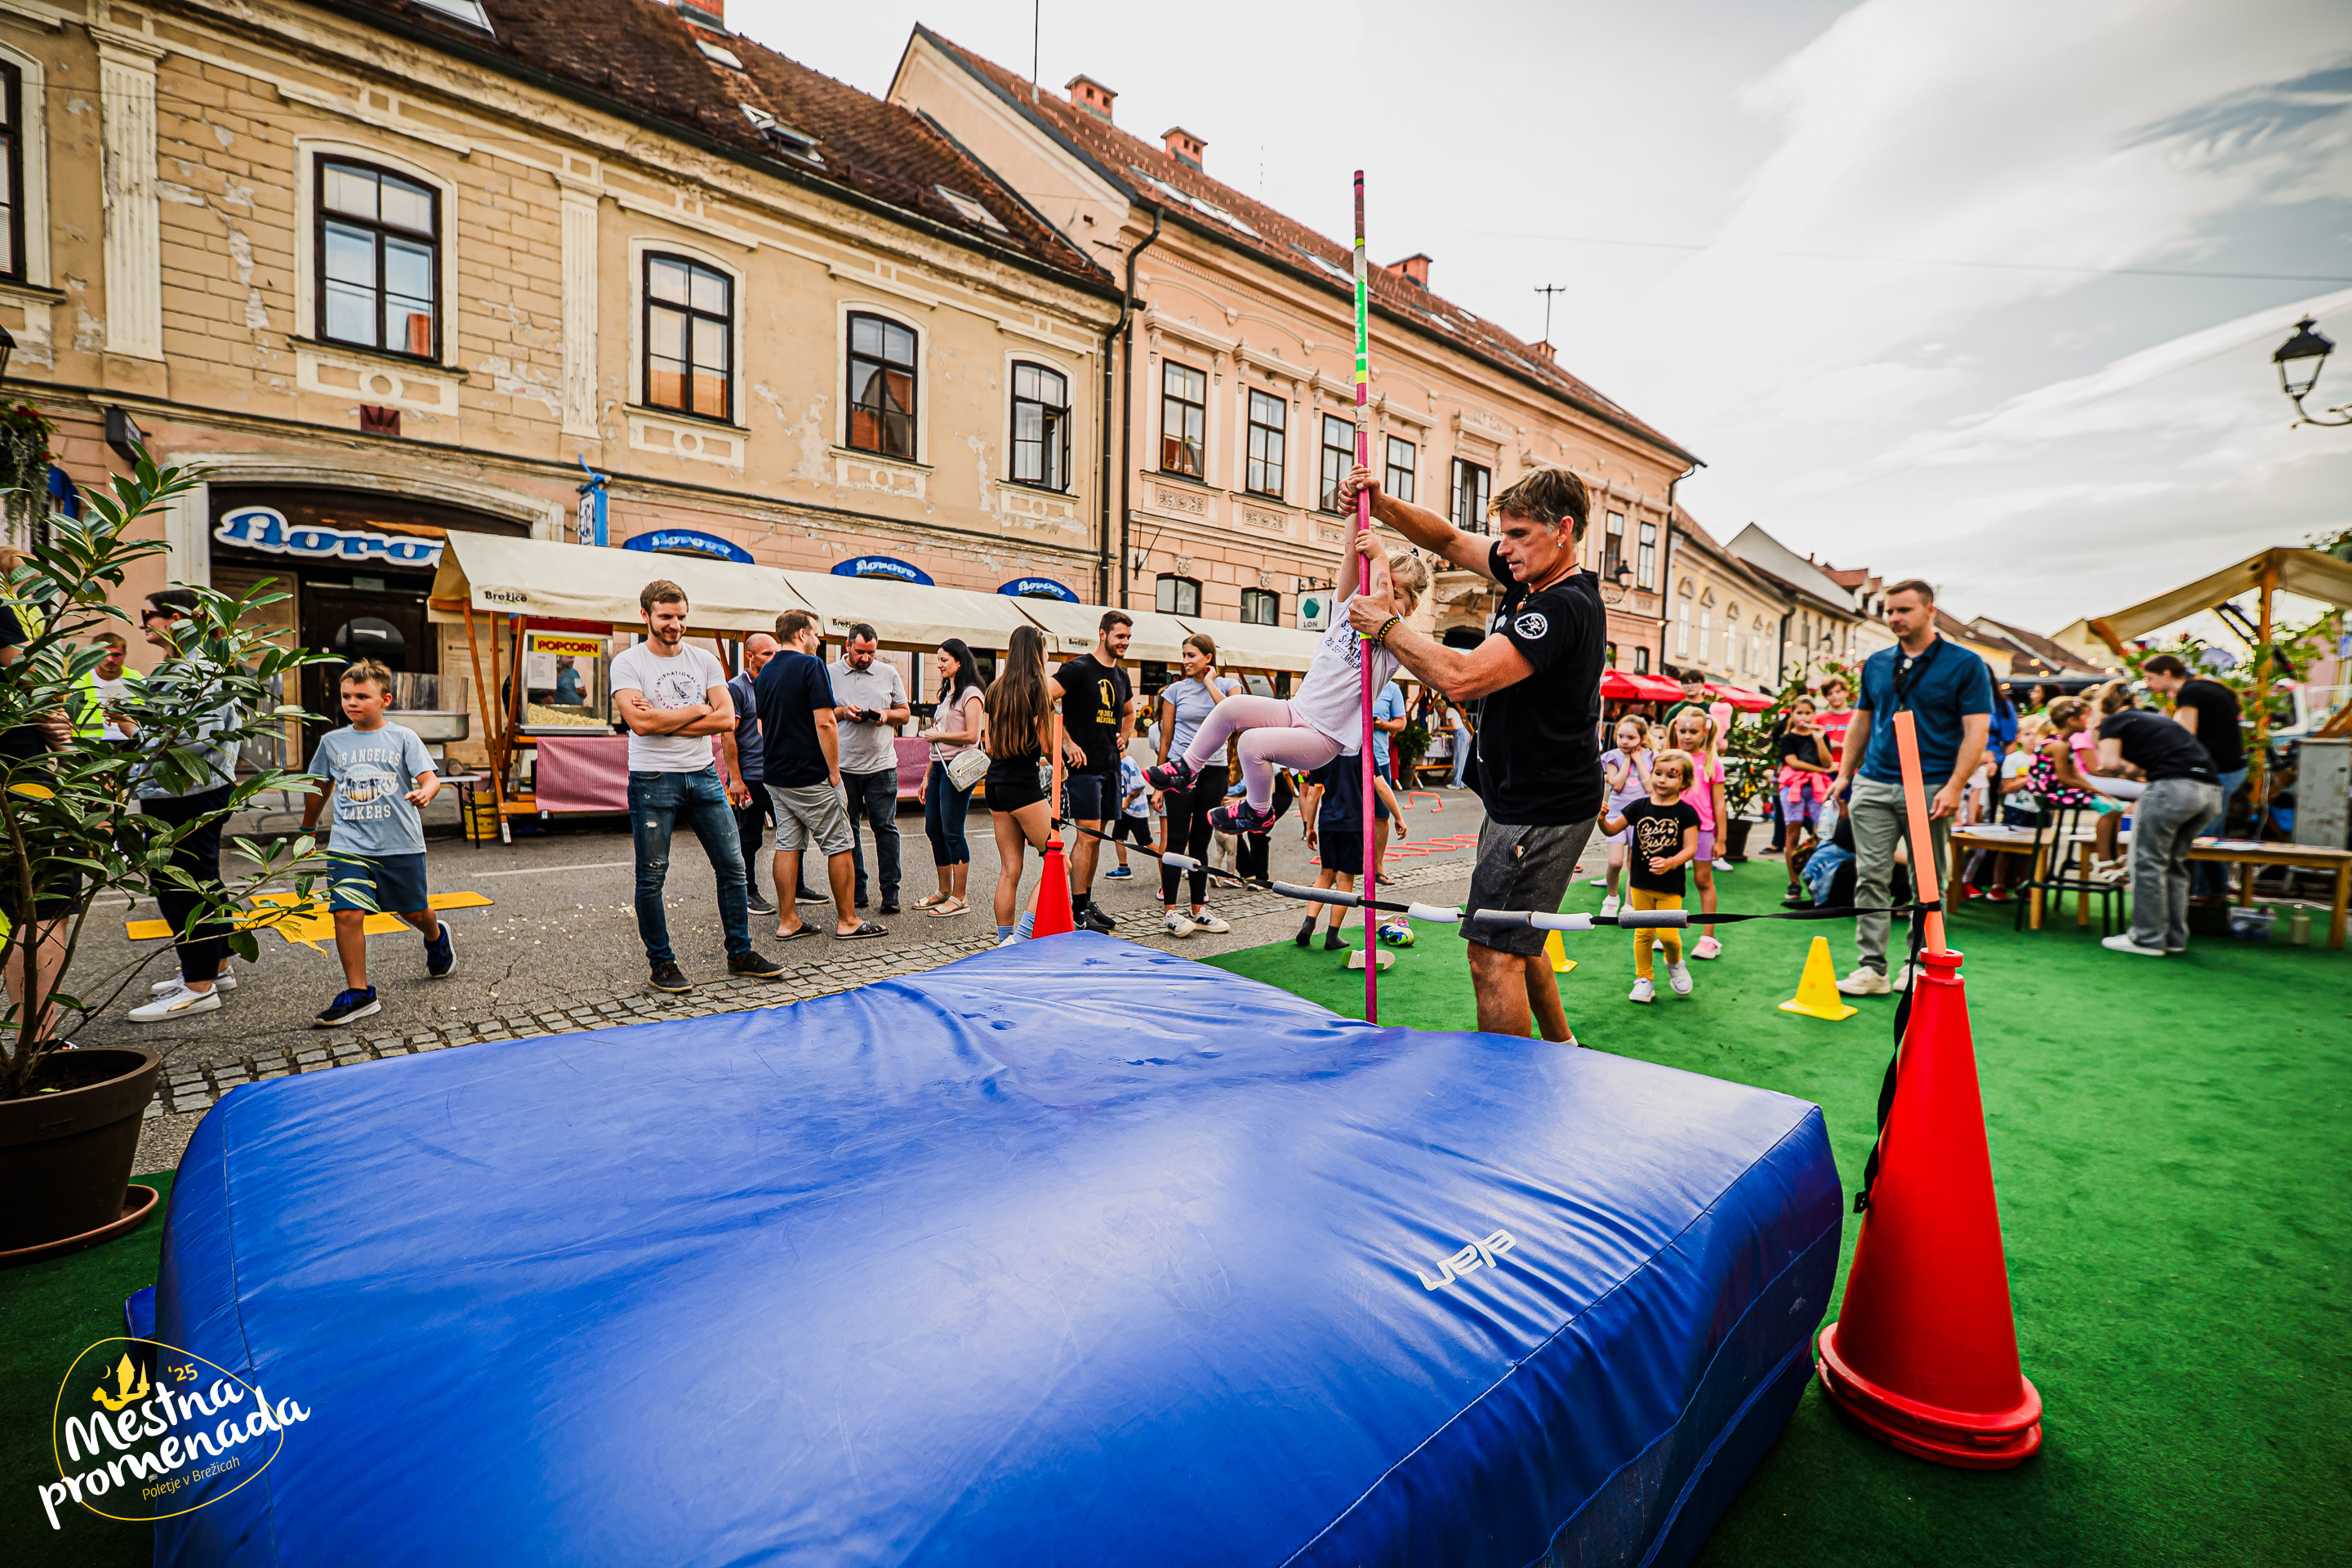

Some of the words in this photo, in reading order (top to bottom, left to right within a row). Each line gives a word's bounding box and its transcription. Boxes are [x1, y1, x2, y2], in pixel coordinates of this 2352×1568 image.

[537, 639, 598, 653] POPCORN
[333, 751, 348, 770] LOS
[350, 748, 401, 768] ANGELES
[342, 804, 391, 821] LAKERS
[1641, 822, 1667, 836] Best
[1640, 835, 1677, 849] Sister
[1415, 1228, 1517, 1291] elan
